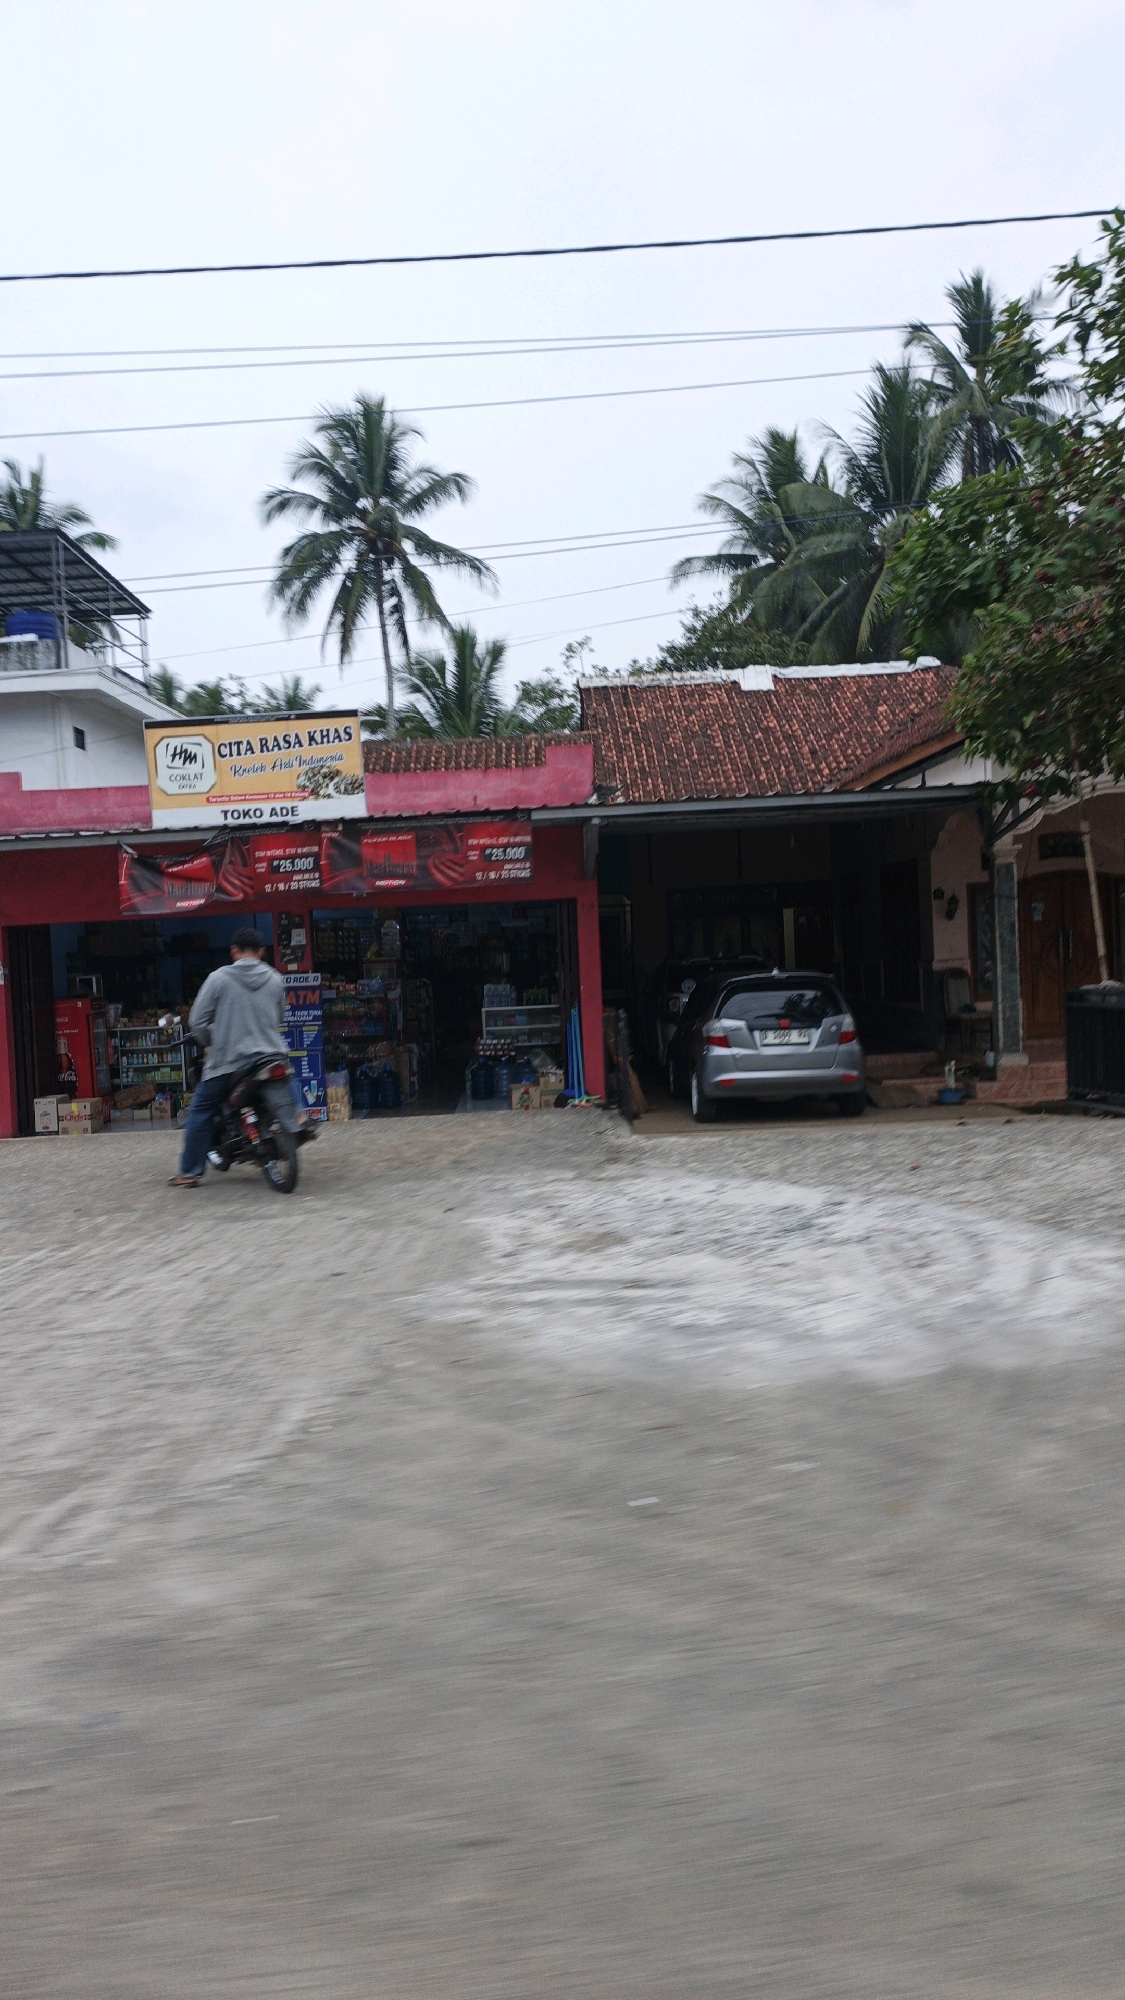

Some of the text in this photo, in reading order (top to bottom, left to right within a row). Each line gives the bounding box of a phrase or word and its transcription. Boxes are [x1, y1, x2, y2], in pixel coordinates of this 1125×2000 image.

[218, 726, 353, 758] CITA RASA KHAS
[230, 752, 344, 778] Kretek Asli Indonesia
[169, 772, 204, 782] COKLAT
[221, 806, 299, 820] TOKO ADE
[285, 989, 320, 1005] ATM
